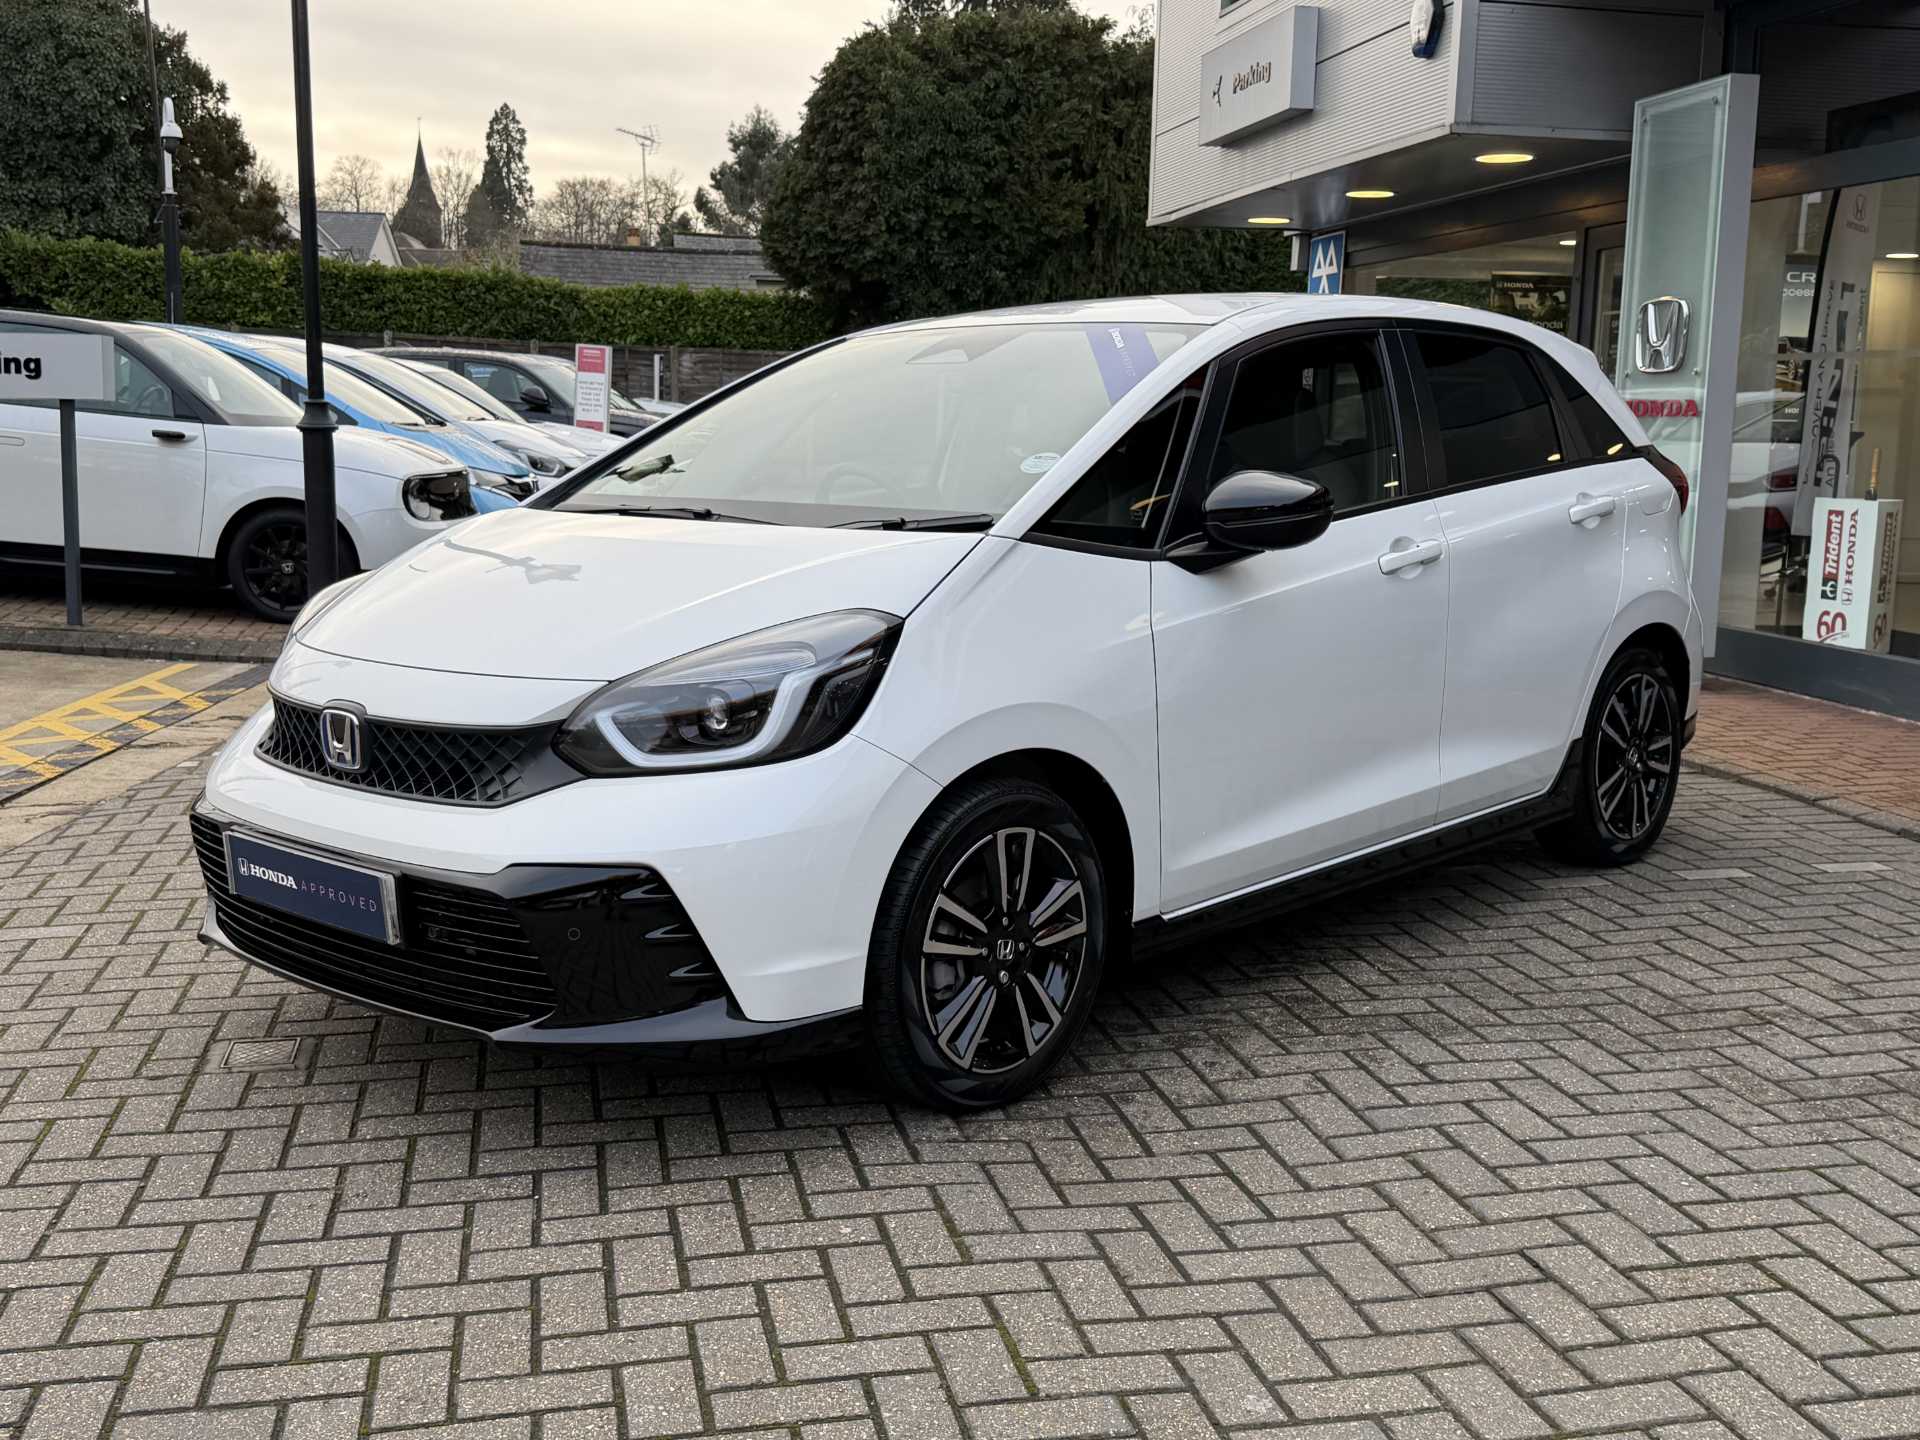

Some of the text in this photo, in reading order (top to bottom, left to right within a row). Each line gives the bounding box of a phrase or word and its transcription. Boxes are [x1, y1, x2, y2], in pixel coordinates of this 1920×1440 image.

[1232, 61, 1272, 95] Parking
[0, 350, 42, 380] ng
[1824, 512, 1843, 575] Trident
[1844, 509, 1860, 585] HONDA
[249, 863, 378, 913] HONDA APPROVED
